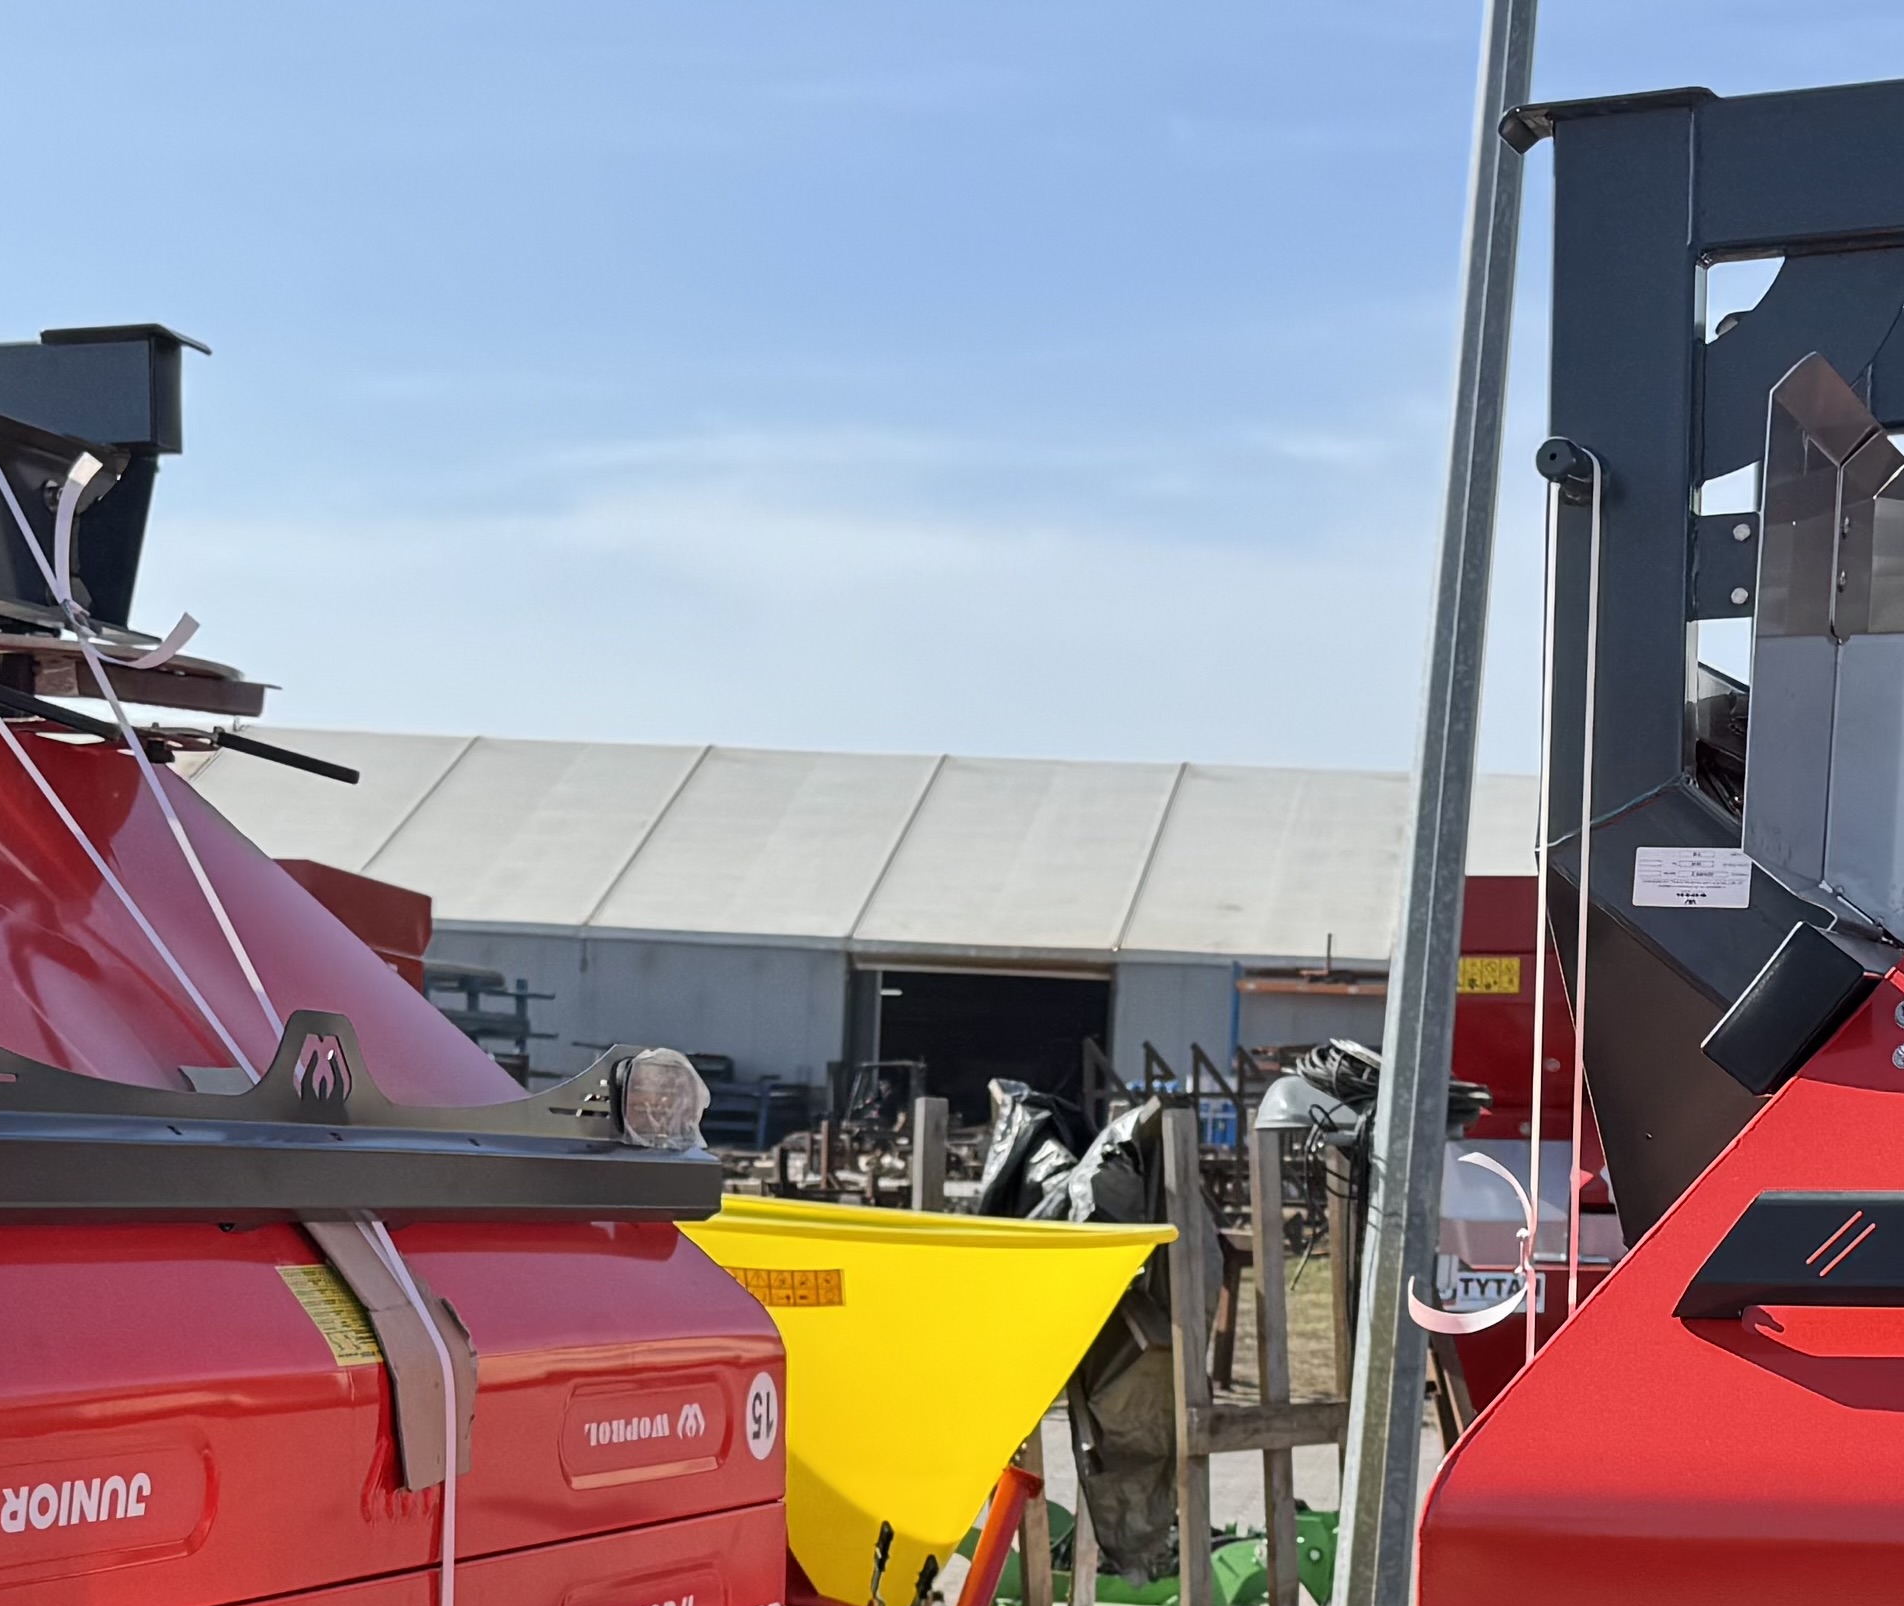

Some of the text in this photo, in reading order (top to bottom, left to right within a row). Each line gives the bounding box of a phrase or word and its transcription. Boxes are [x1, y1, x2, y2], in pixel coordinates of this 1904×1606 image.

[1459, 1277, 1542, 1298] TYTA
[584, 1413, 670, 1447] WOPROL
[751, 1391, 775, 1440] 15
[1, 1473, 151, 1533] JUNIOR
